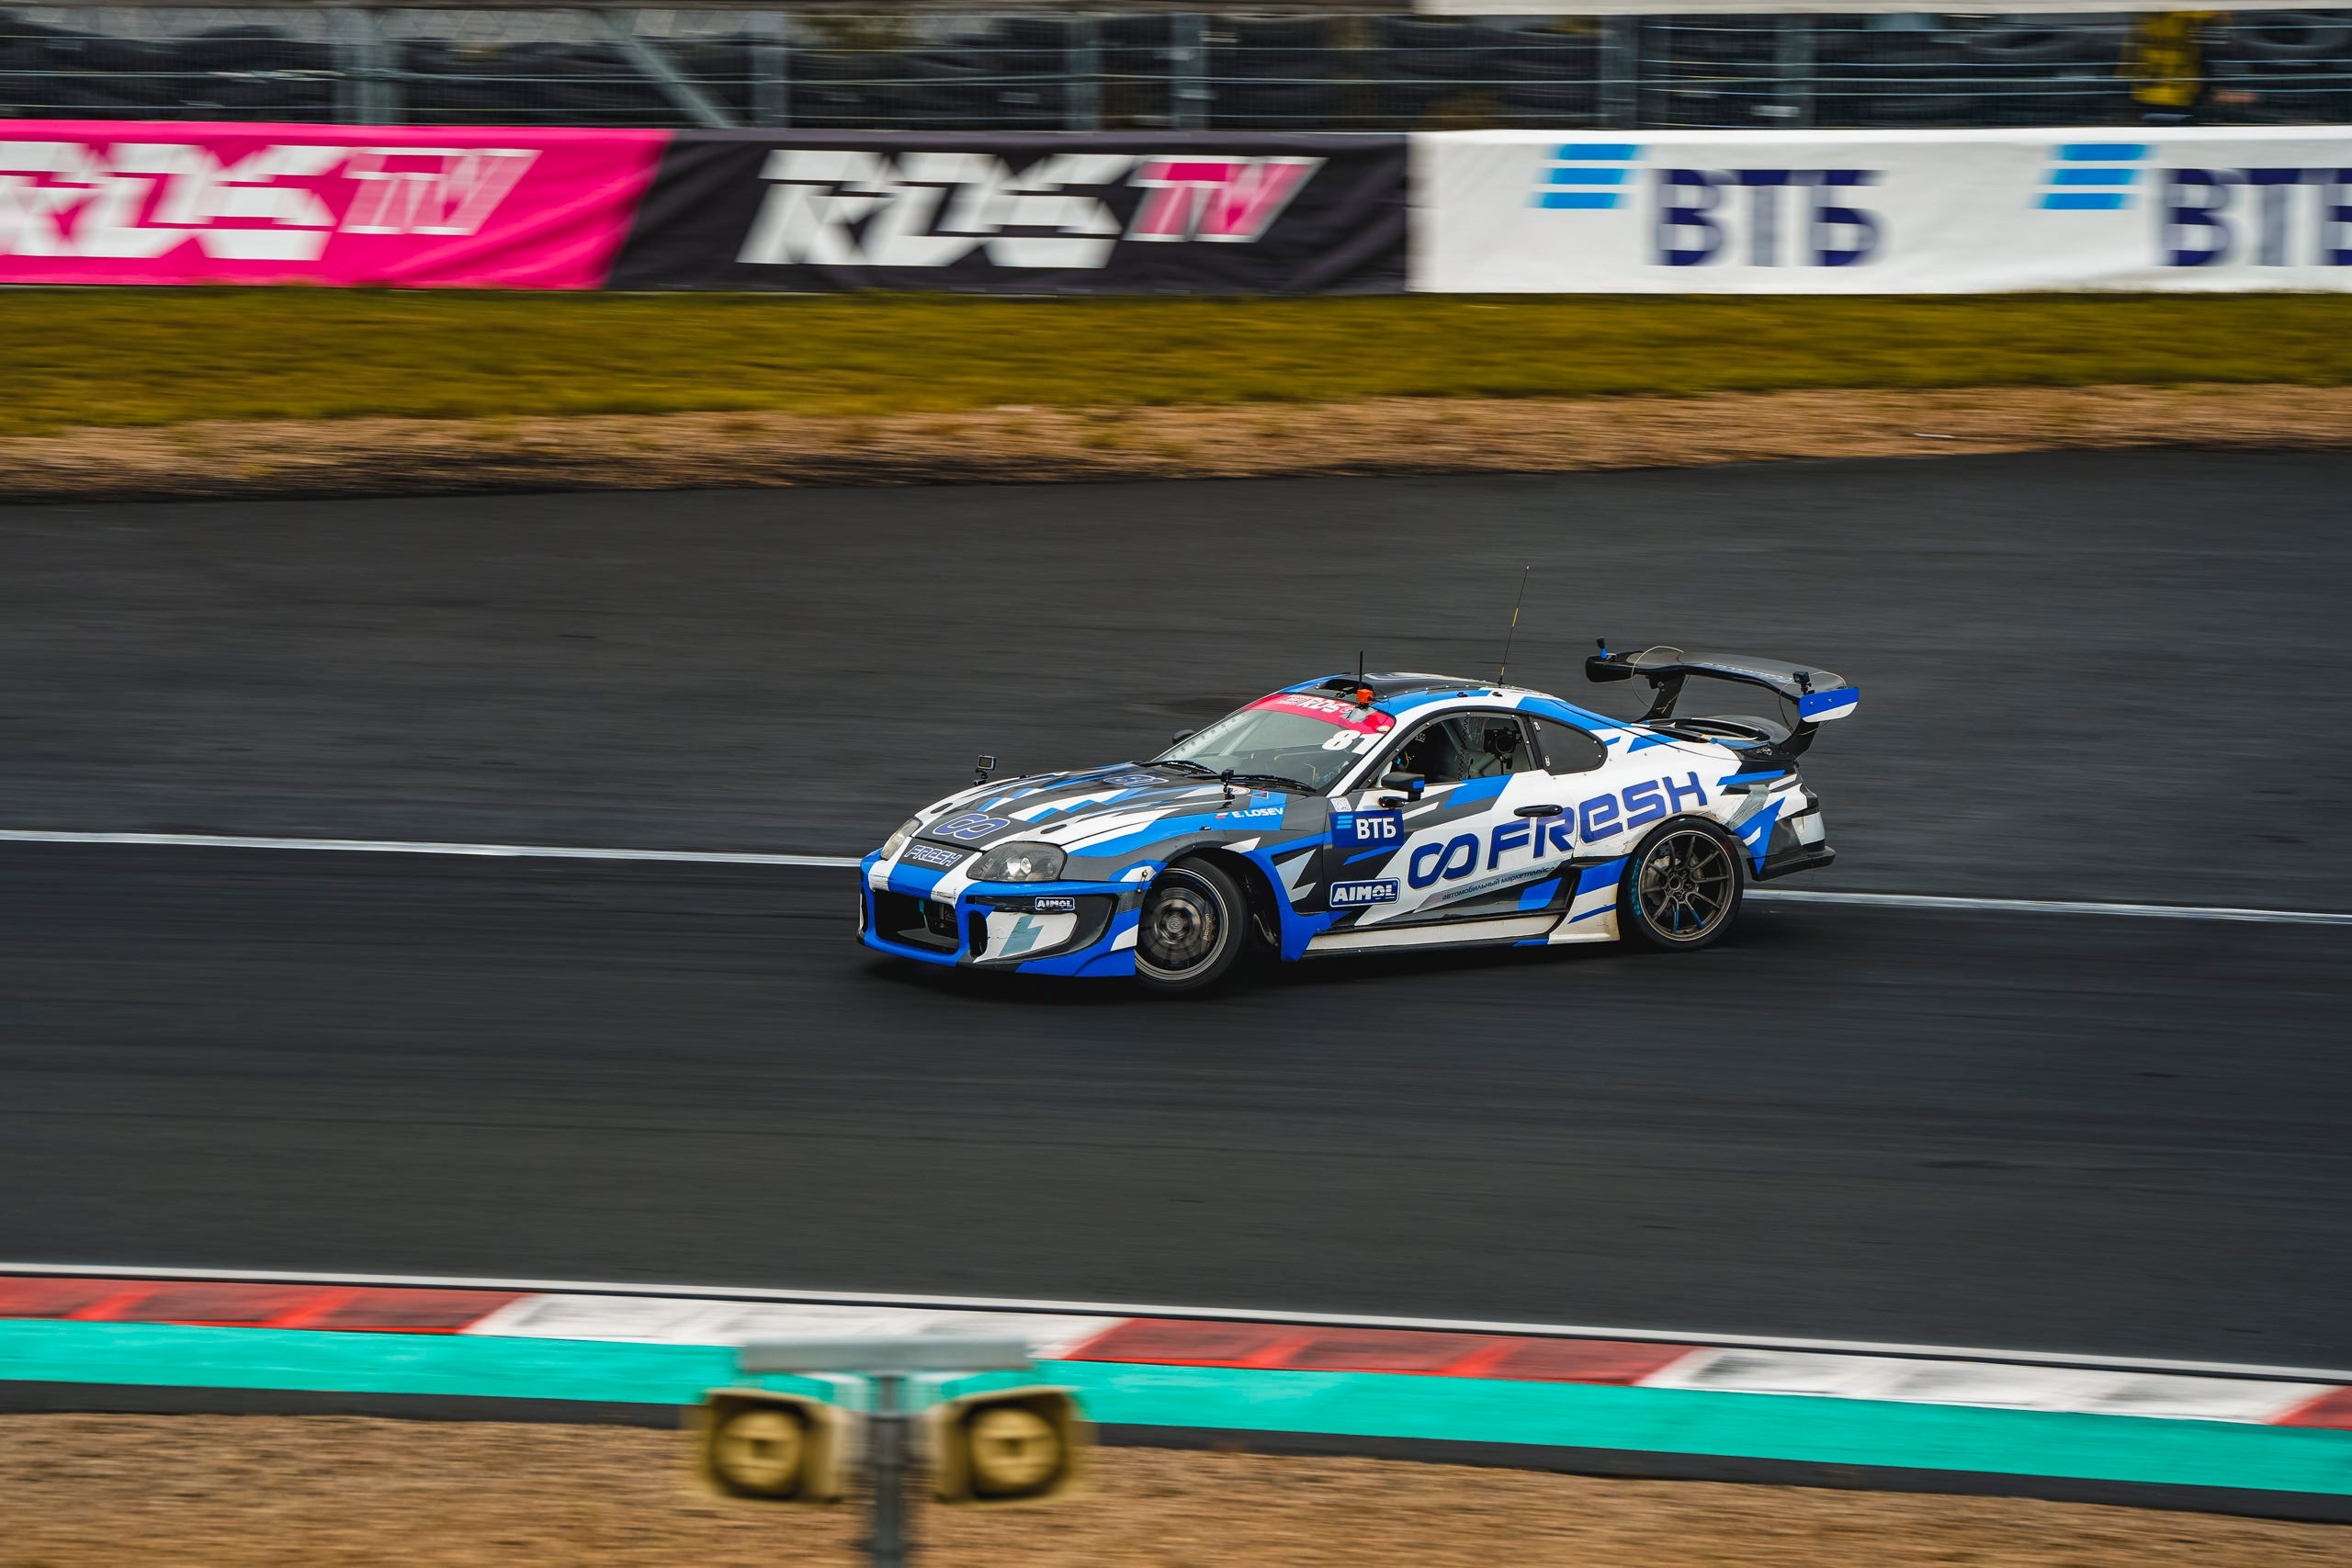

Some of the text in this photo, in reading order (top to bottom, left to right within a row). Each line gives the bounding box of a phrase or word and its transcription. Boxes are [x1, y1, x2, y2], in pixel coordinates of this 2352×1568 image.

[337, 147, 543, 236] TV
[736, 149, 1328, 268] RDS TV
[1651, 169, 1888, 266] ВТБ
[1296, 697, 1351, 713] RDS
[1232, 807, 1283, 818] E. LOSEV
[1355, 817, 1396, 840] ВТБ
[1332, 884, 1396, 902] AIMOL
[1442, 877, 1500, 900] автомобильный
[1036, 898, 1074, 908] AIMOL
